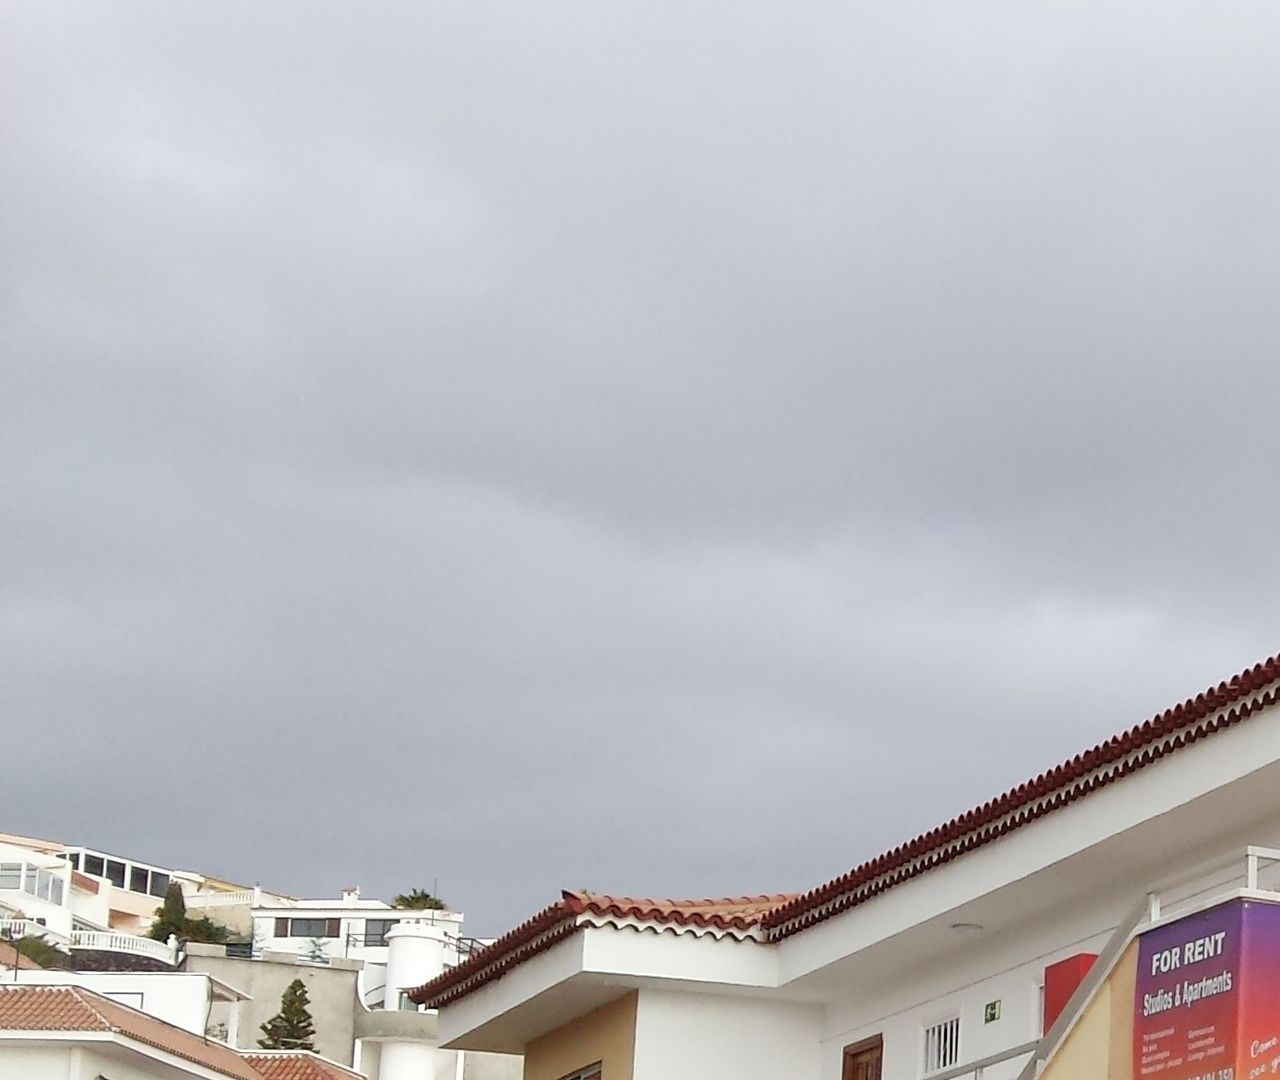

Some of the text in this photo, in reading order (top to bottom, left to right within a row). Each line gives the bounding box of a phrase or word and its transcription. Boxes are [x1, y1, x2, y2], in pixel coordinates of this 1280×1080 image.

[1151, 931, 1226, 976] FOR RENT
[1143, 970, 1232, 1017] Studios & Apartments
[1250, 1036, 1279, 1058] Come
